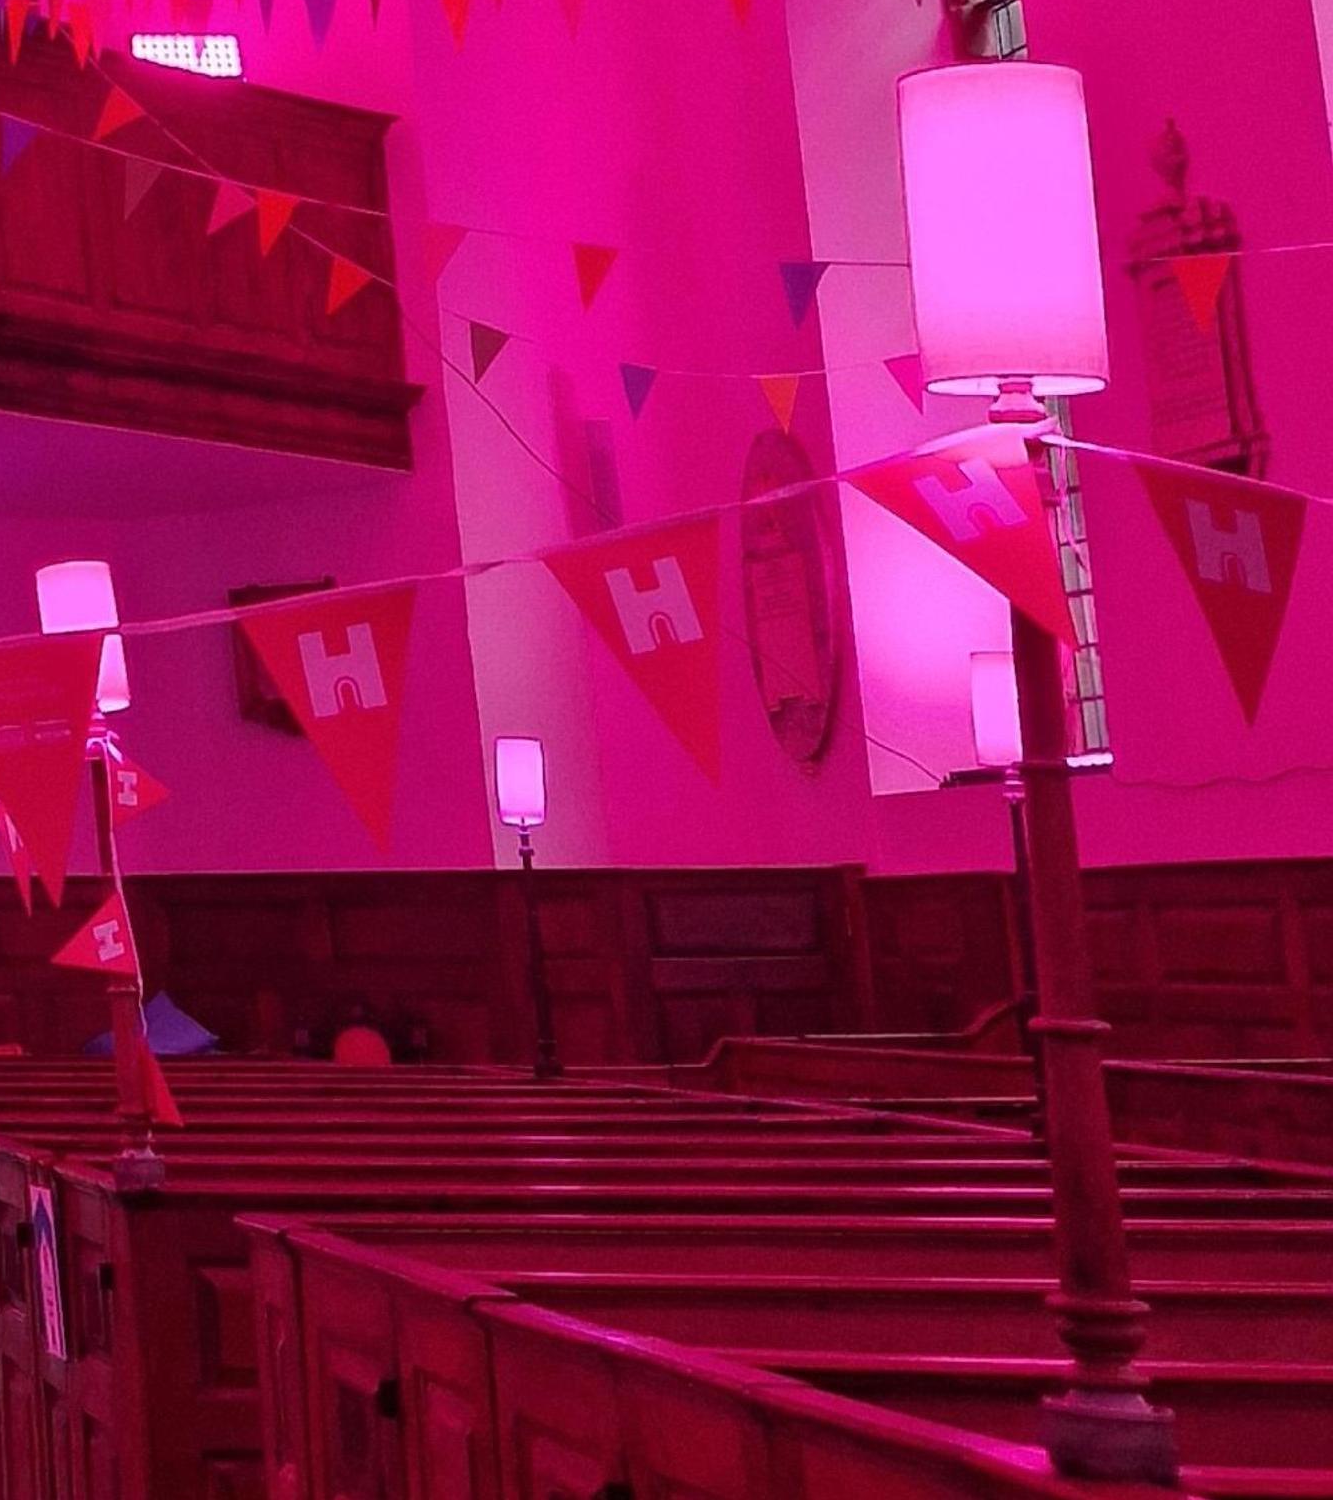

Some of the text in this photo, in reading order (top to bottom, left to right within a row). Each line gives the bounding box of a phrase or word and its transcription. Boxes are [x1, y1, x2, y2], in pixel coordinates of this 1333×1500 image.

[913, 458, 1028, 543] H
[1185, 499, 1272, 594] H
[605, 556, 704, 654] H
[298, 622, 387, 717] H
[117, 771, 139, 805] H
[93, 920, 124, 961] H
